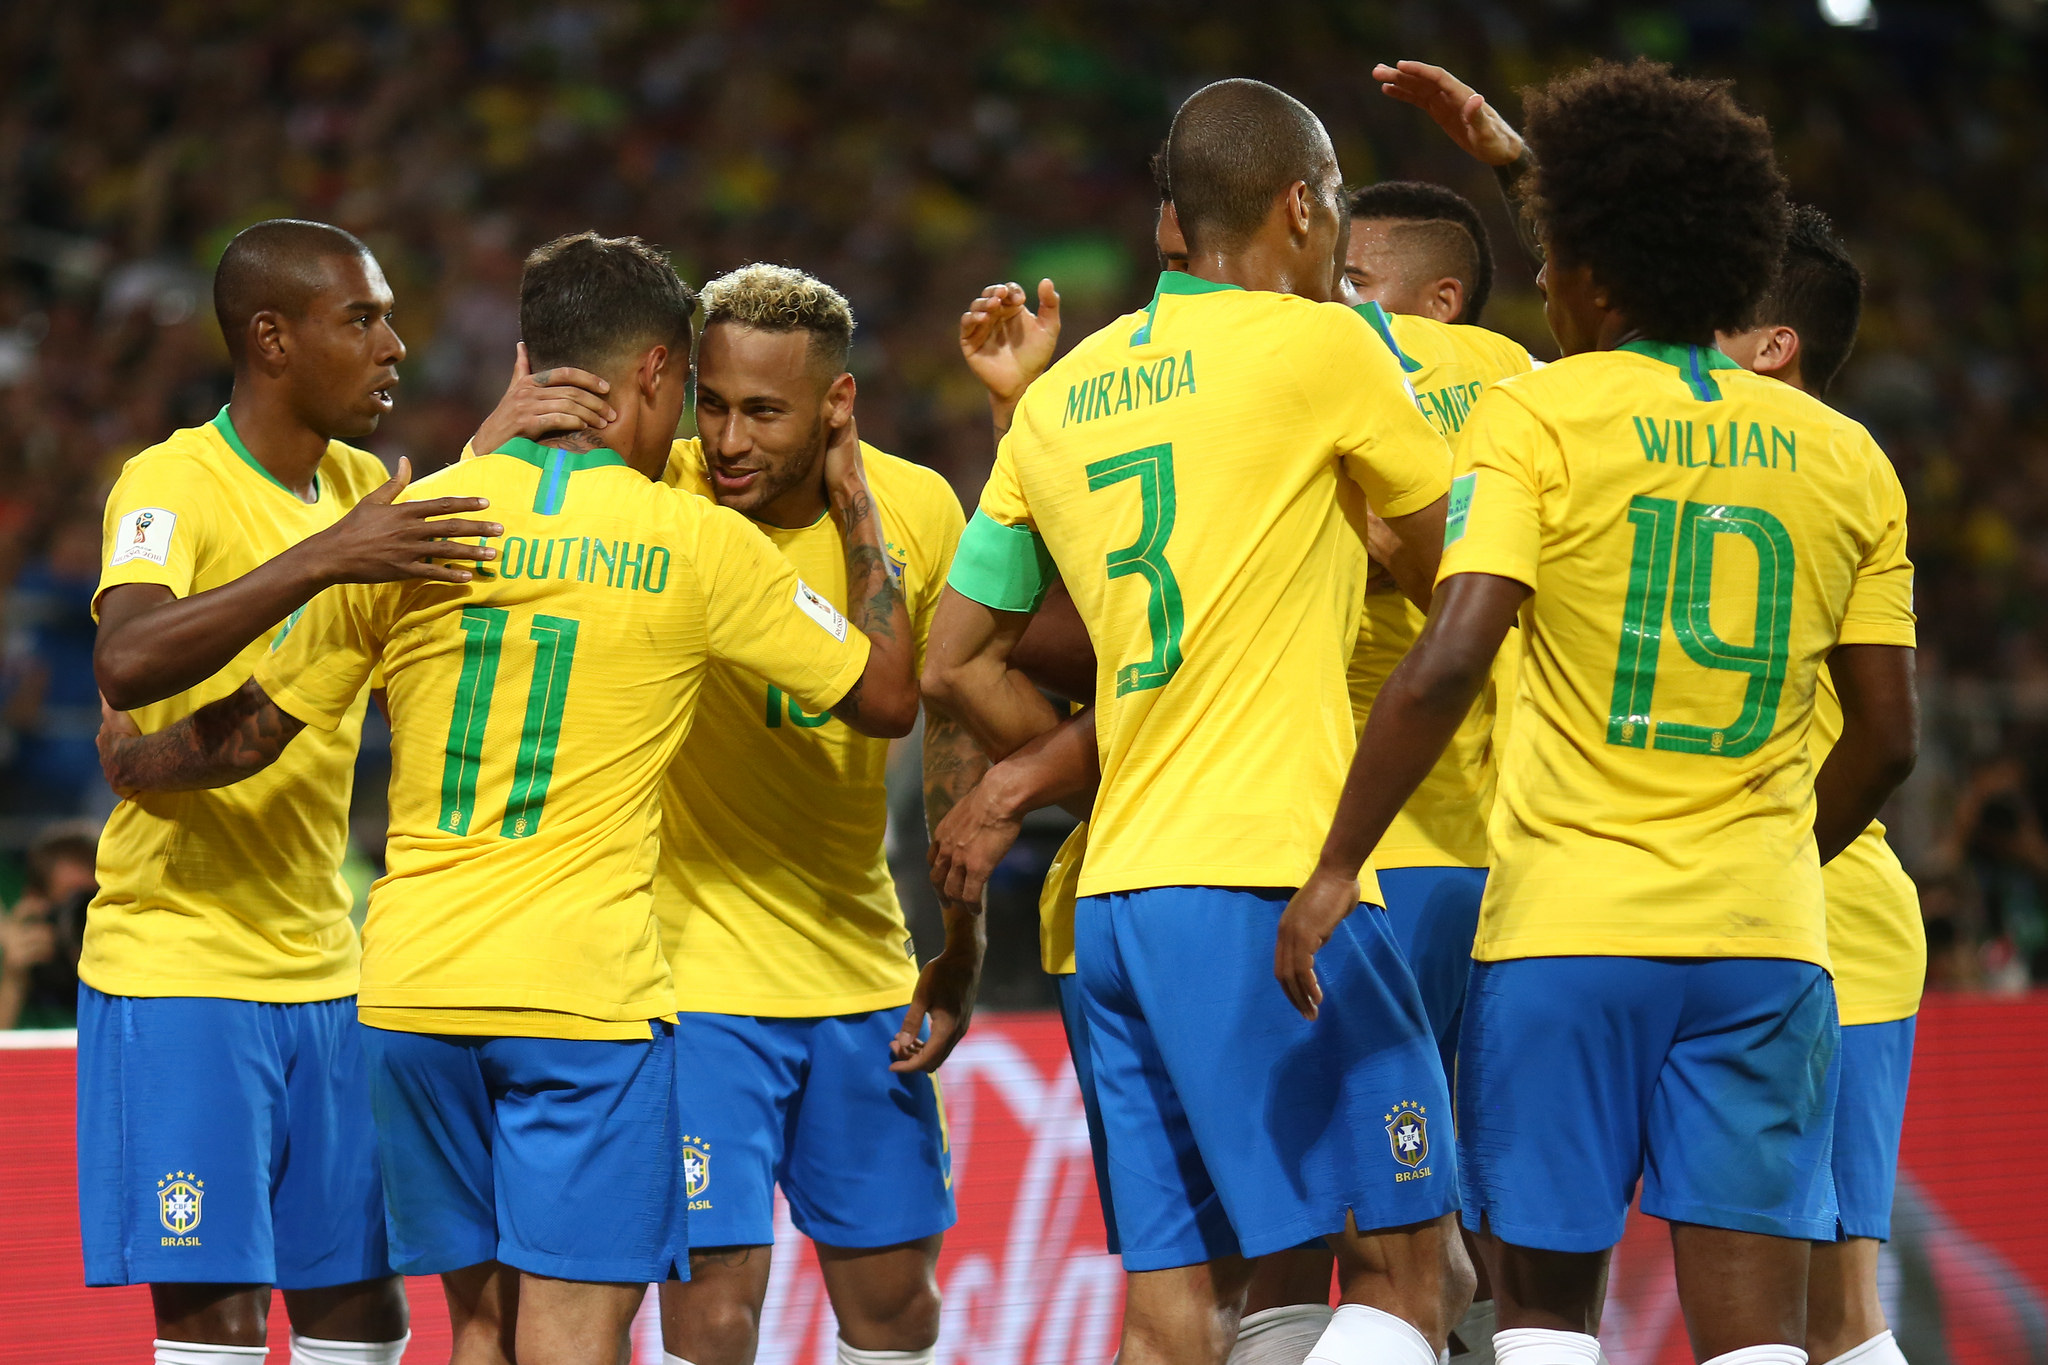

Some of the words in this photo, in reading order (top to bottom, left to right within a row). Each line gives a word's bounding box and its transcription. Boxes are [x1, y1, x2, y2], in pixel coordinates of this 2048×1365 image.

[1062, 350, 1196, 429] MIRANDA
[1632, 416, 1796, 472] WILLIAN
[1085, 442, 1184, 698] 3
[1605, 494, 1796, 758] 19
[437, 603, 581, 839] 11
[1402, 1133, 1416, 1143] CBF
[1395, 1166, 1432, 1183] BRASIL
[161, 1236, 202, 1247] BRASIL
